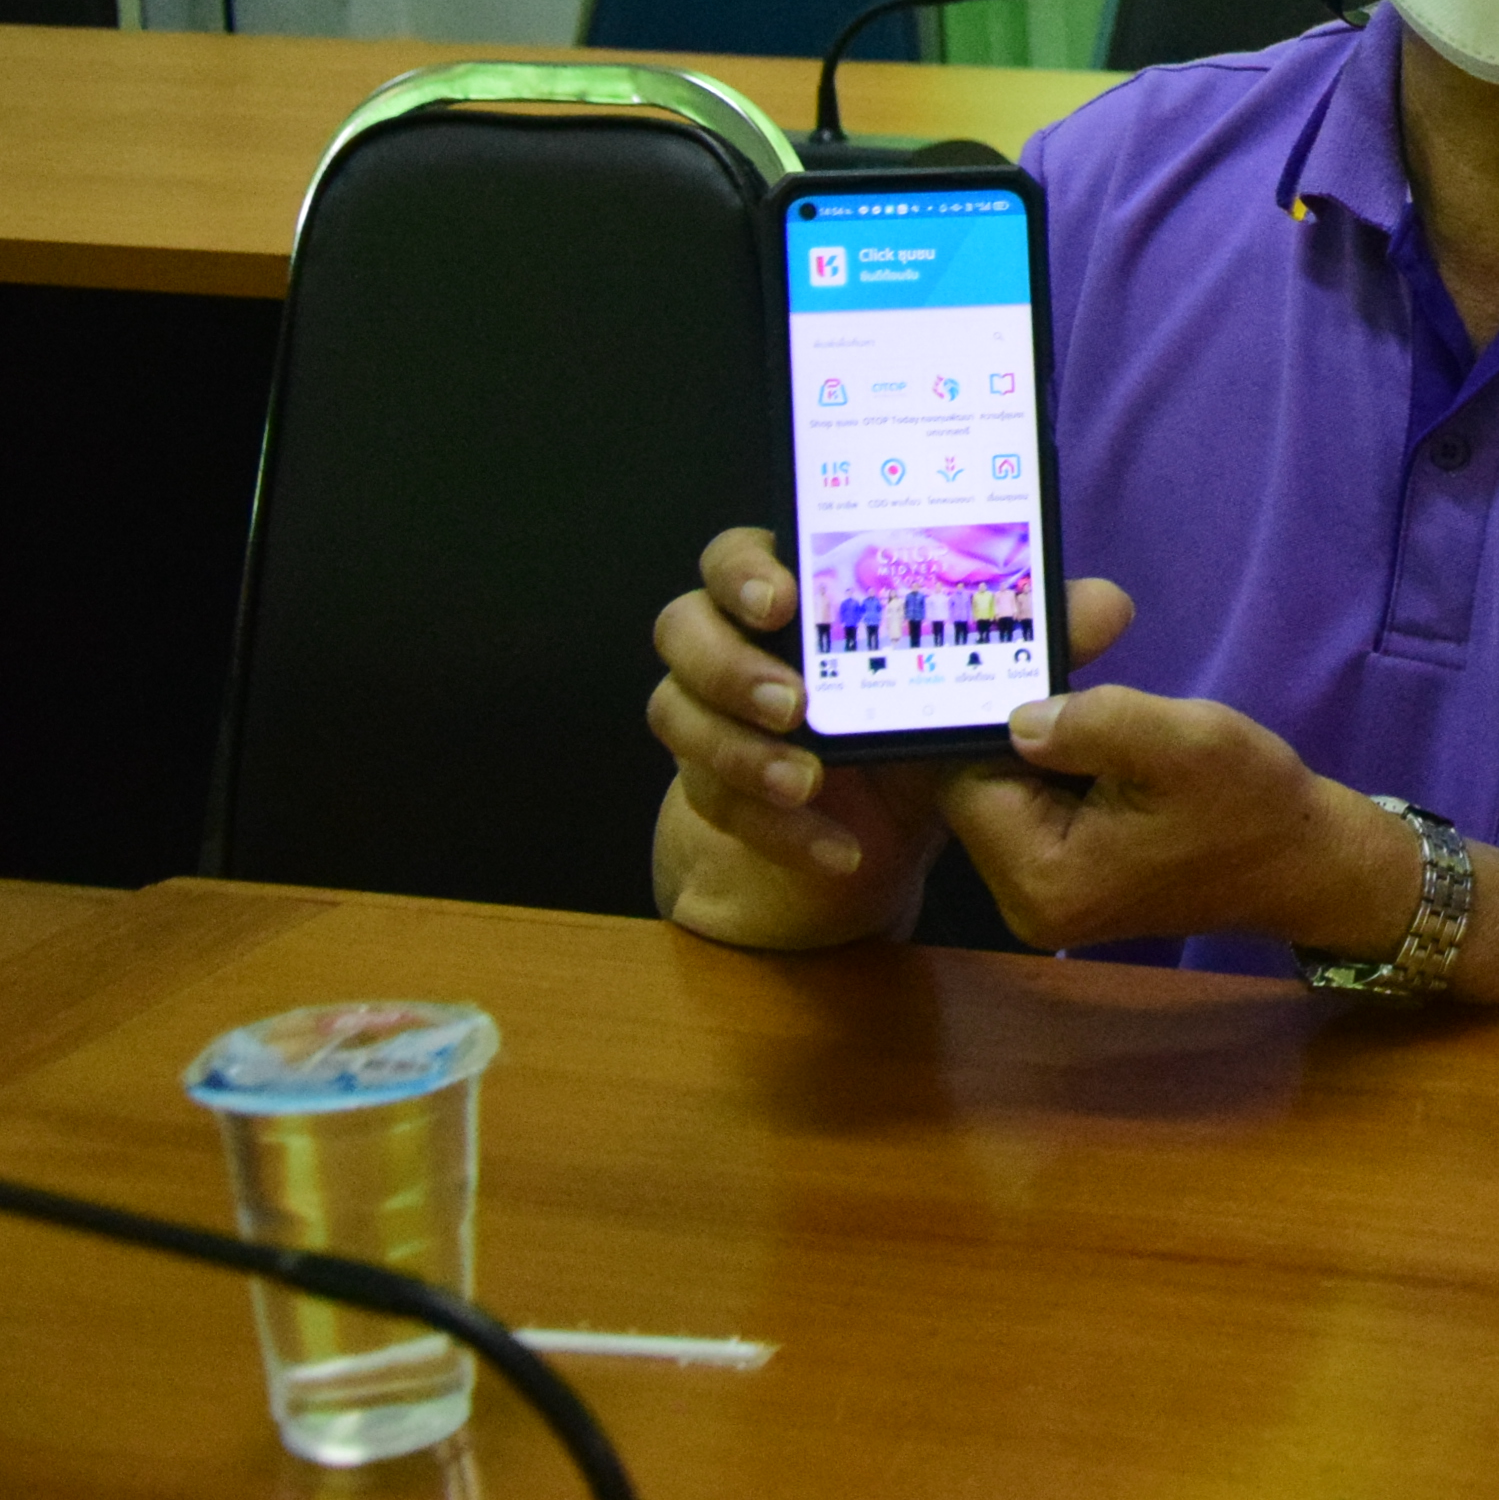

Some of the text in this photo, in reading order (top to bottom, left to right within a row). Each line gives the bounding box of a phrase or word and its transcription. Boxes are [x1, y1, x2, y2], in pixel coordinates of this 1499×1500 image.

[859, 248, 936, 265] Click ชุมชน
[871, 381, 907, 393] OTOP
